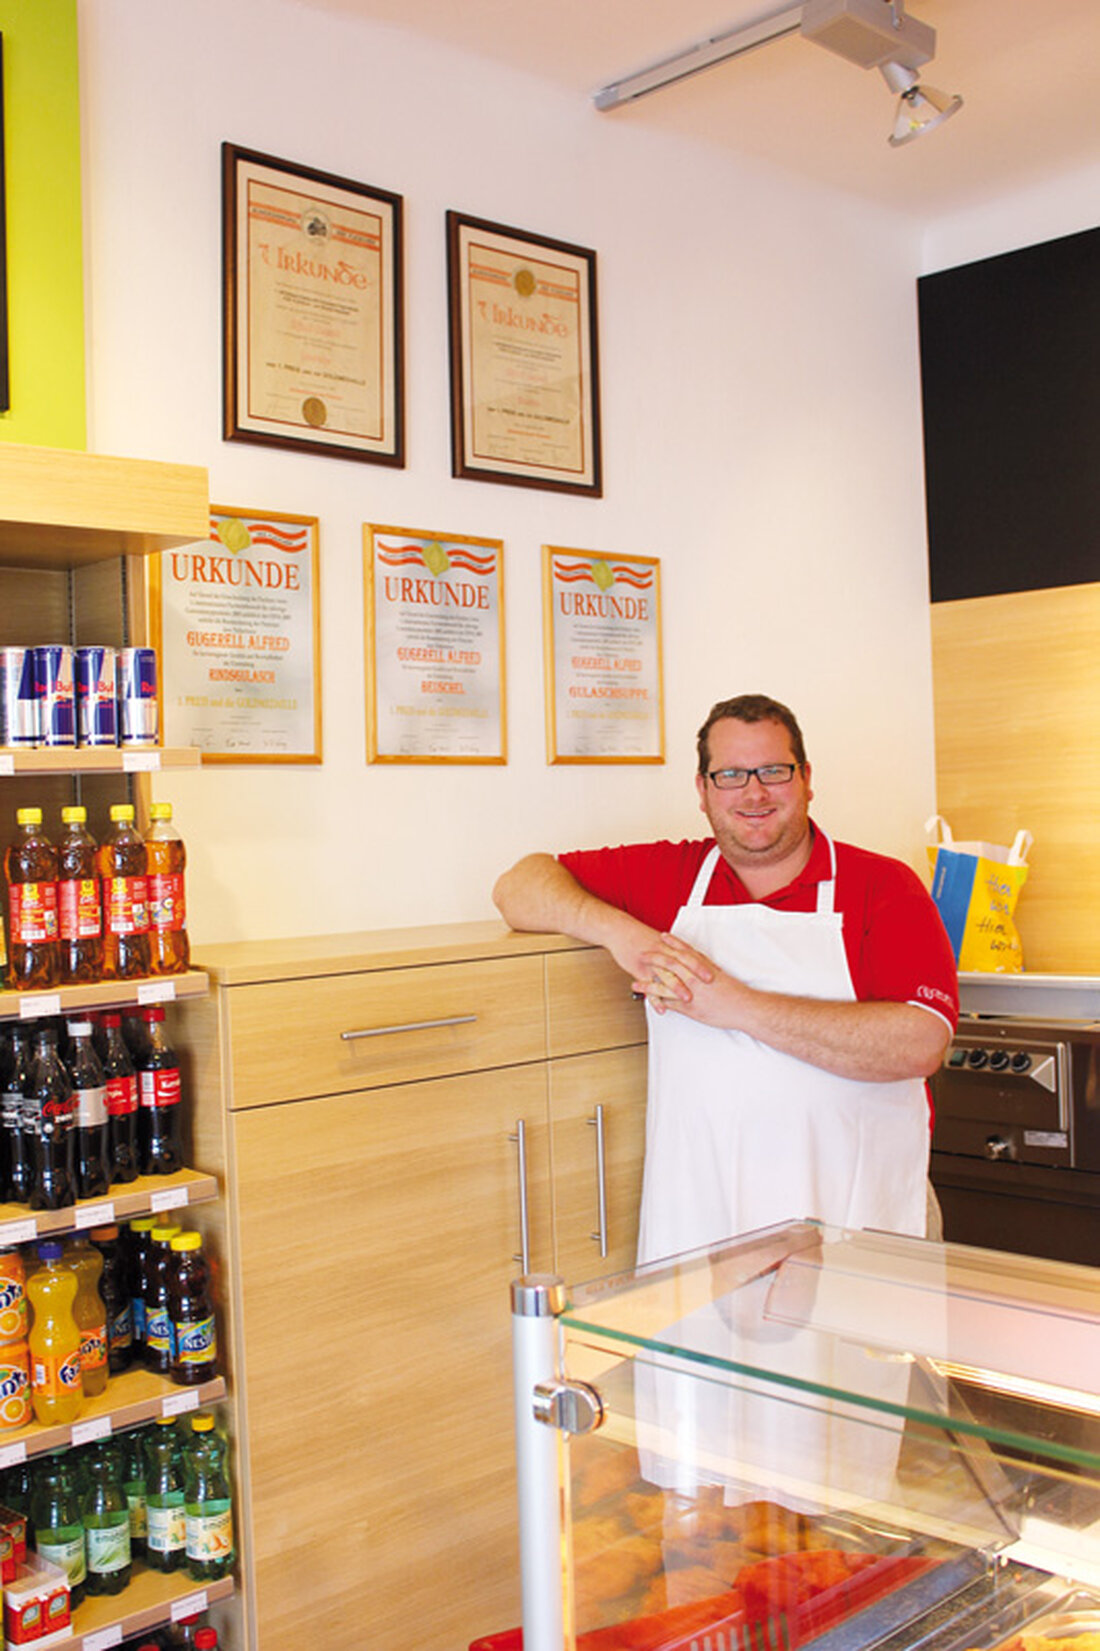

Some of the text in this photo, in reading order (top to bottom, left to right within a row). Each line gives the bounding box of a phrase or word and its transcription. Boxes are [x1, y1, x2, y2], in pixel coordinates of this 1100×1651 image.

[170, 552, 301, 591] URKUNDE
[384, 575, 490, 610] URKUNDE
[559, 591, 649, 621] URKUNDE
[247, 634, 290, 652] ALFRED
